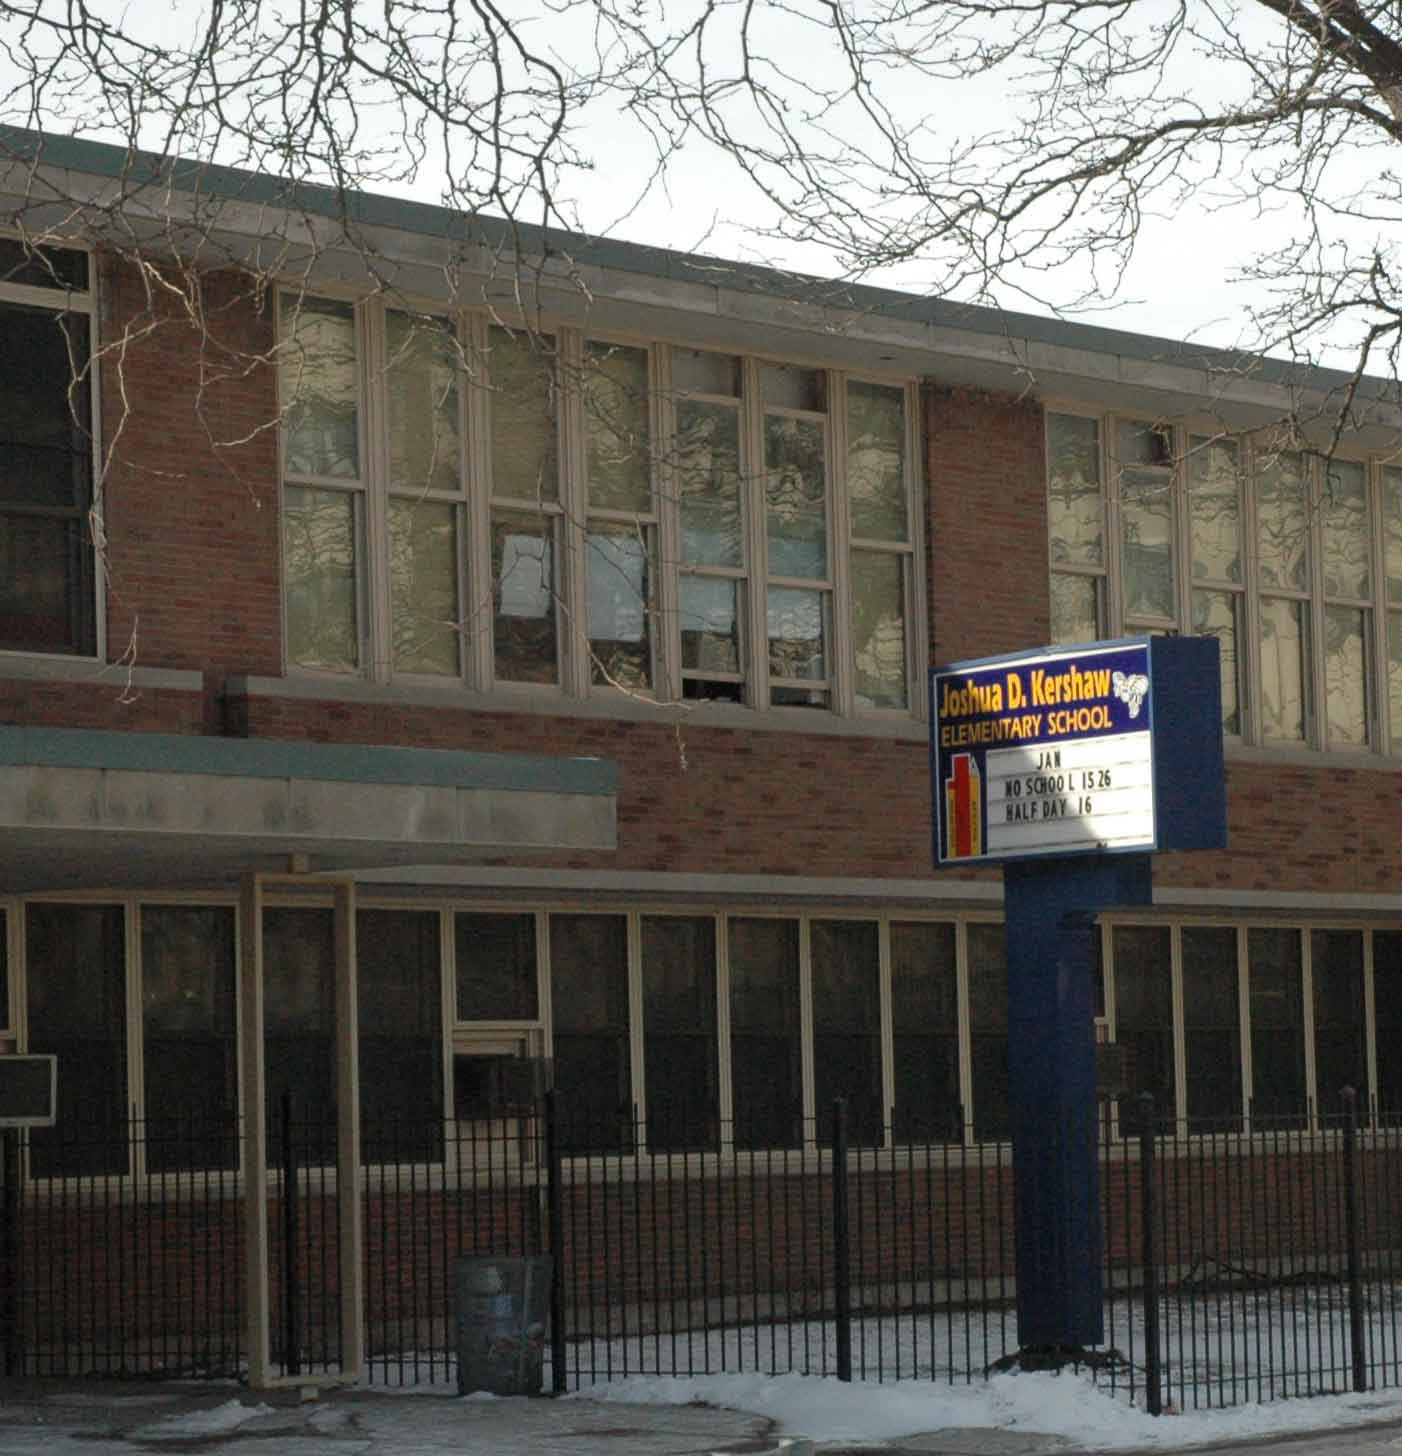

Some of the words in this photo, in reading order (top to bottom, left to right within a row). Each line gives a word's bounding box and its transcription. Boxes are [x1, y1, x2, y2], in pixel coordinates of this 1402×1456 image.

[940, 679, 1003, 718] Joshua
[1007, 672, 1027, 709] D.
[1030, 664, 1111, 707] Kershaw
[941, 714, 1042, 747] ELEMENTARY
[1048, 705, 1112, 734] SCHOOL
[1036, 751, 1061, 770] JAN
[1005, 779, 1021, 798] NO
[1098, 770, 1111, 788] 26
[1005, 802, 1037, 822] HALF
[1043, 799, 1067, 817] DAY
[1078, 797, 1092, 814] 16
